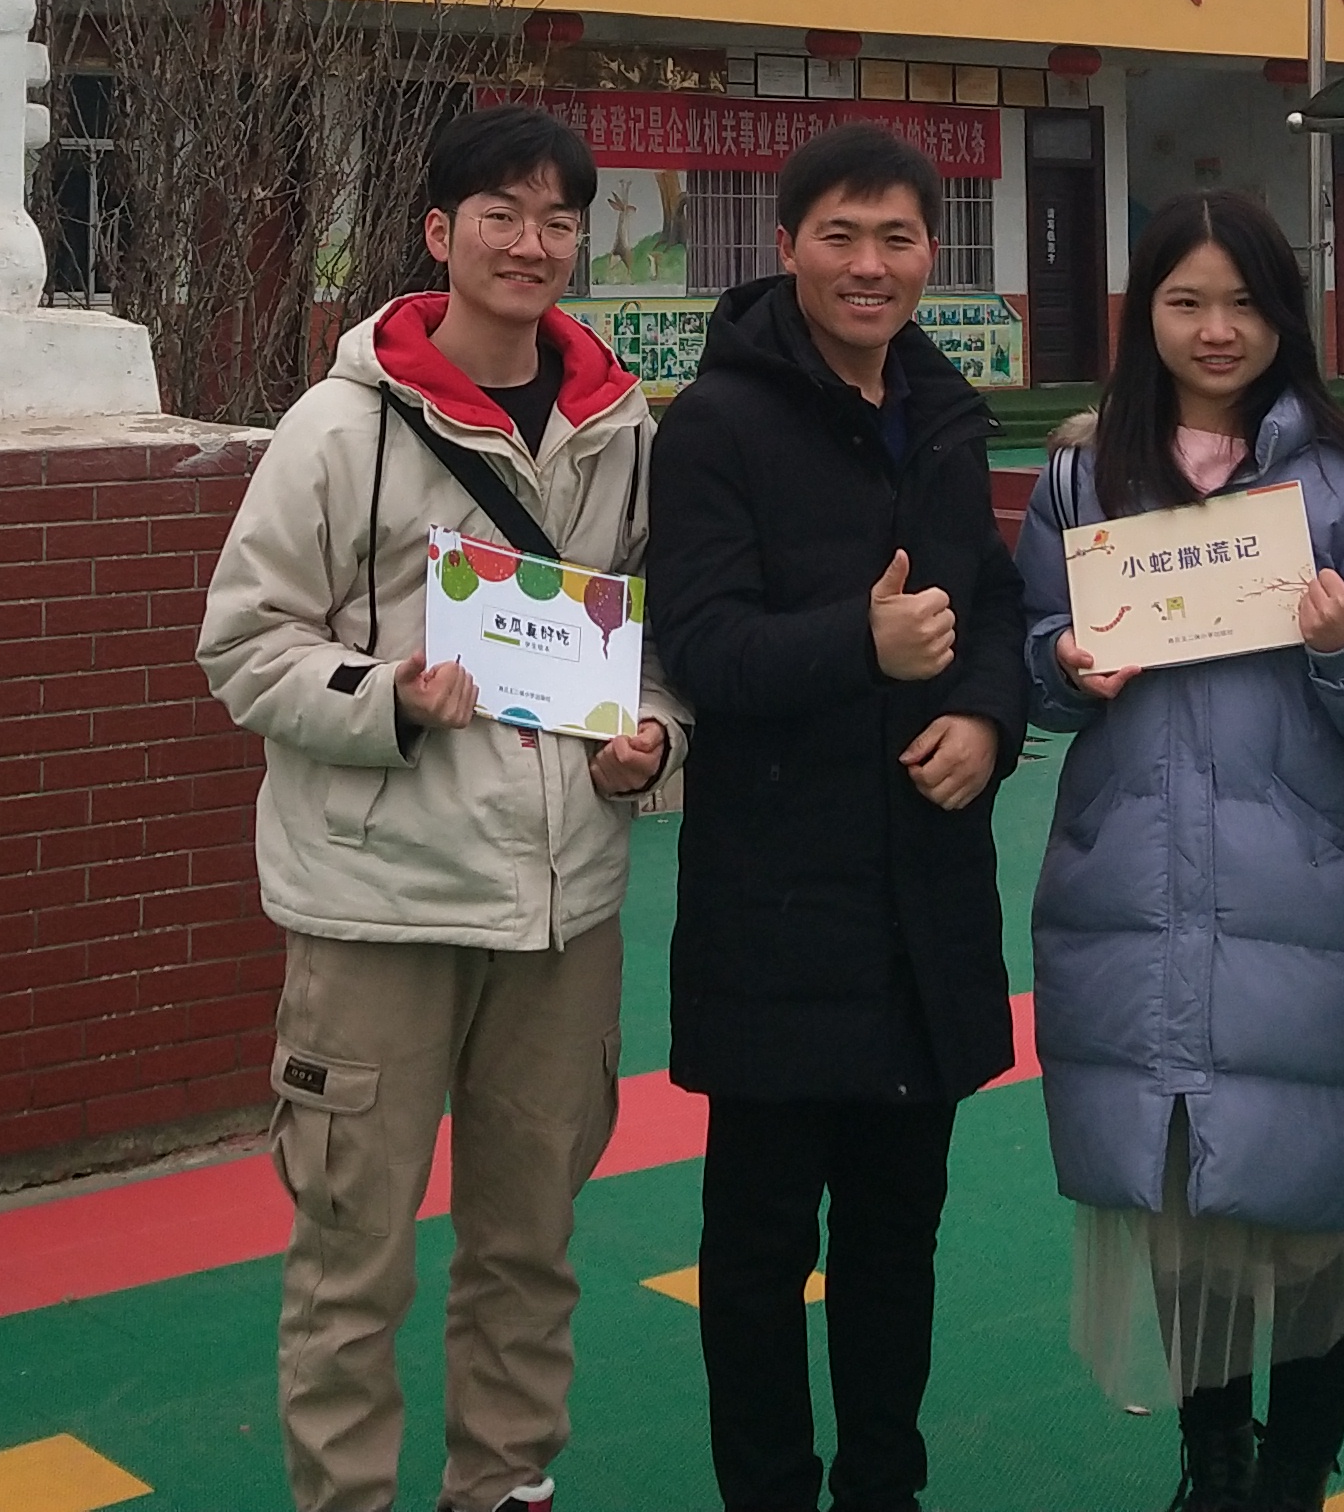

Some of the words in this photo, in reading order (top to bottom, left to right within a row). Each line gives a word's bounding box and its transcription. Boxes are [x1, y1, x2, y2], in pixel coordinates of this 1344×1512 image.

[1121, 535, 1260, 578] 小蛇撒谎记
[494, 613, 571, 646] 西瓜真好吃
